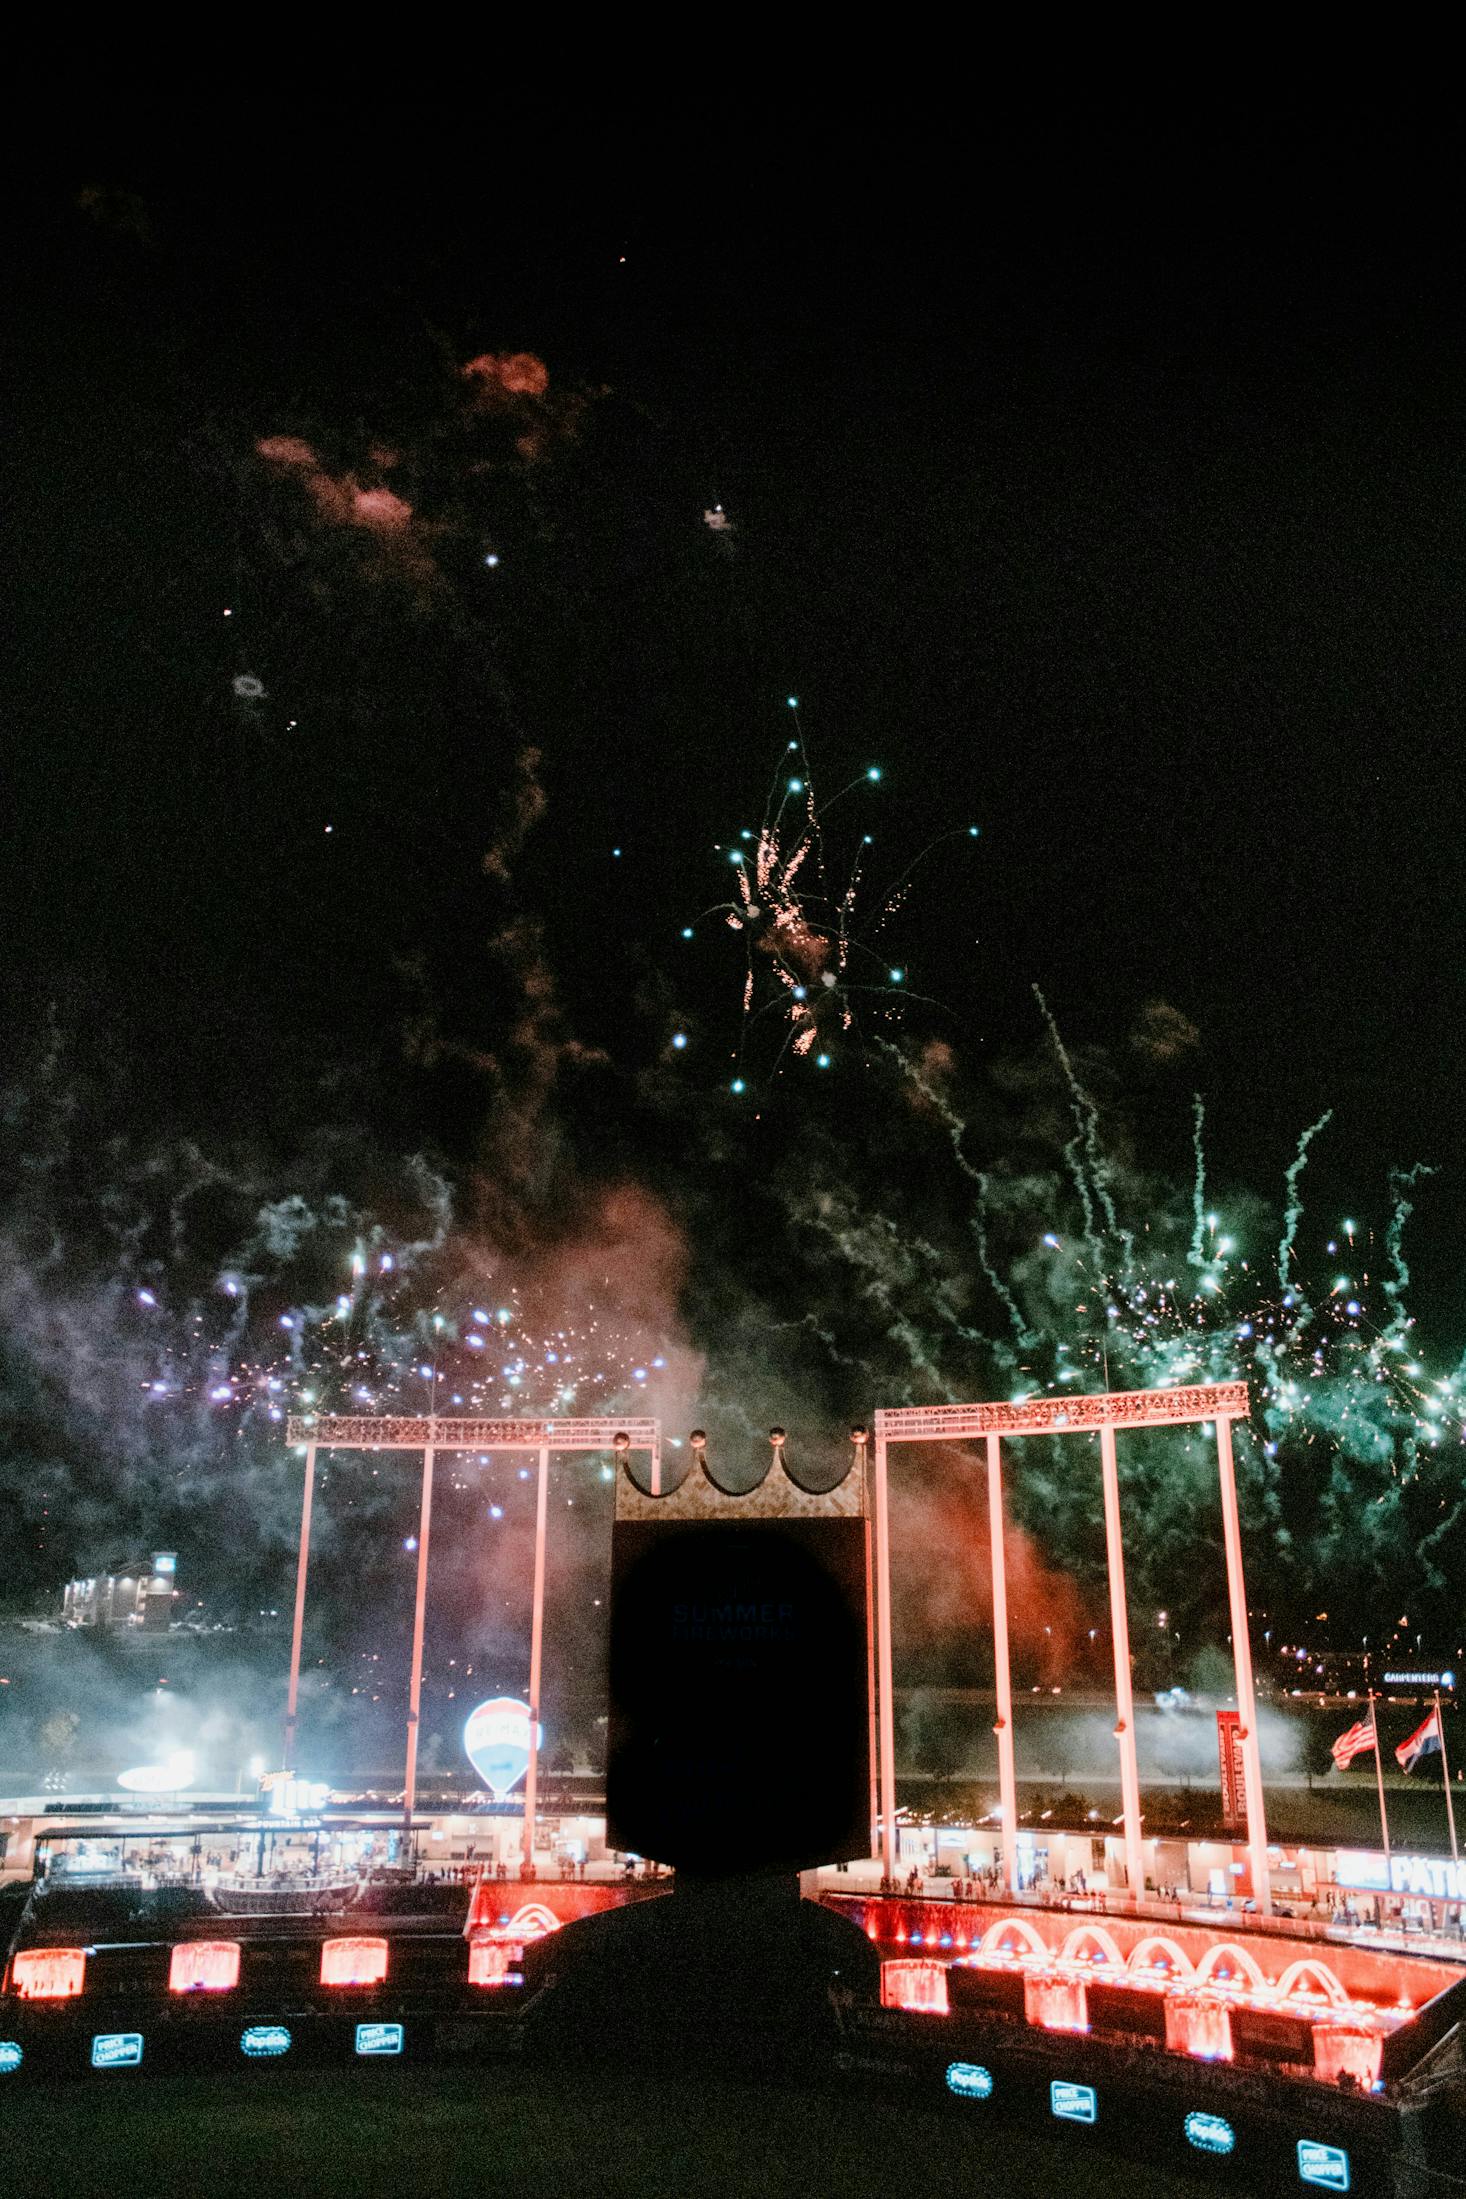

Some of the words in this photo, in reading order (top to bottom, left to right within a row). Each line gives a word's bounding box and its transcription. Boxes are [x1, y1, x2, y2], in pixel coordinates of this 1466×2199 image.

[672, 1602, 793, 1623] SUMMER
[360, 2028, 384, 2039] PRICE
[97, 2038, 123, 2050] PRICE
[359, 2034, 398, 2050] CHOPPER
[95, 2044, 137, 2062] CHOPPER
[1055, 2088, 1079, 2098] PRICE
[1054, 2100, 1091, 2111] CHOPPER
[1301, 2149, 1327, 2161] PRICE
[1301, 2163, 1344, 2176] CHOPPER
